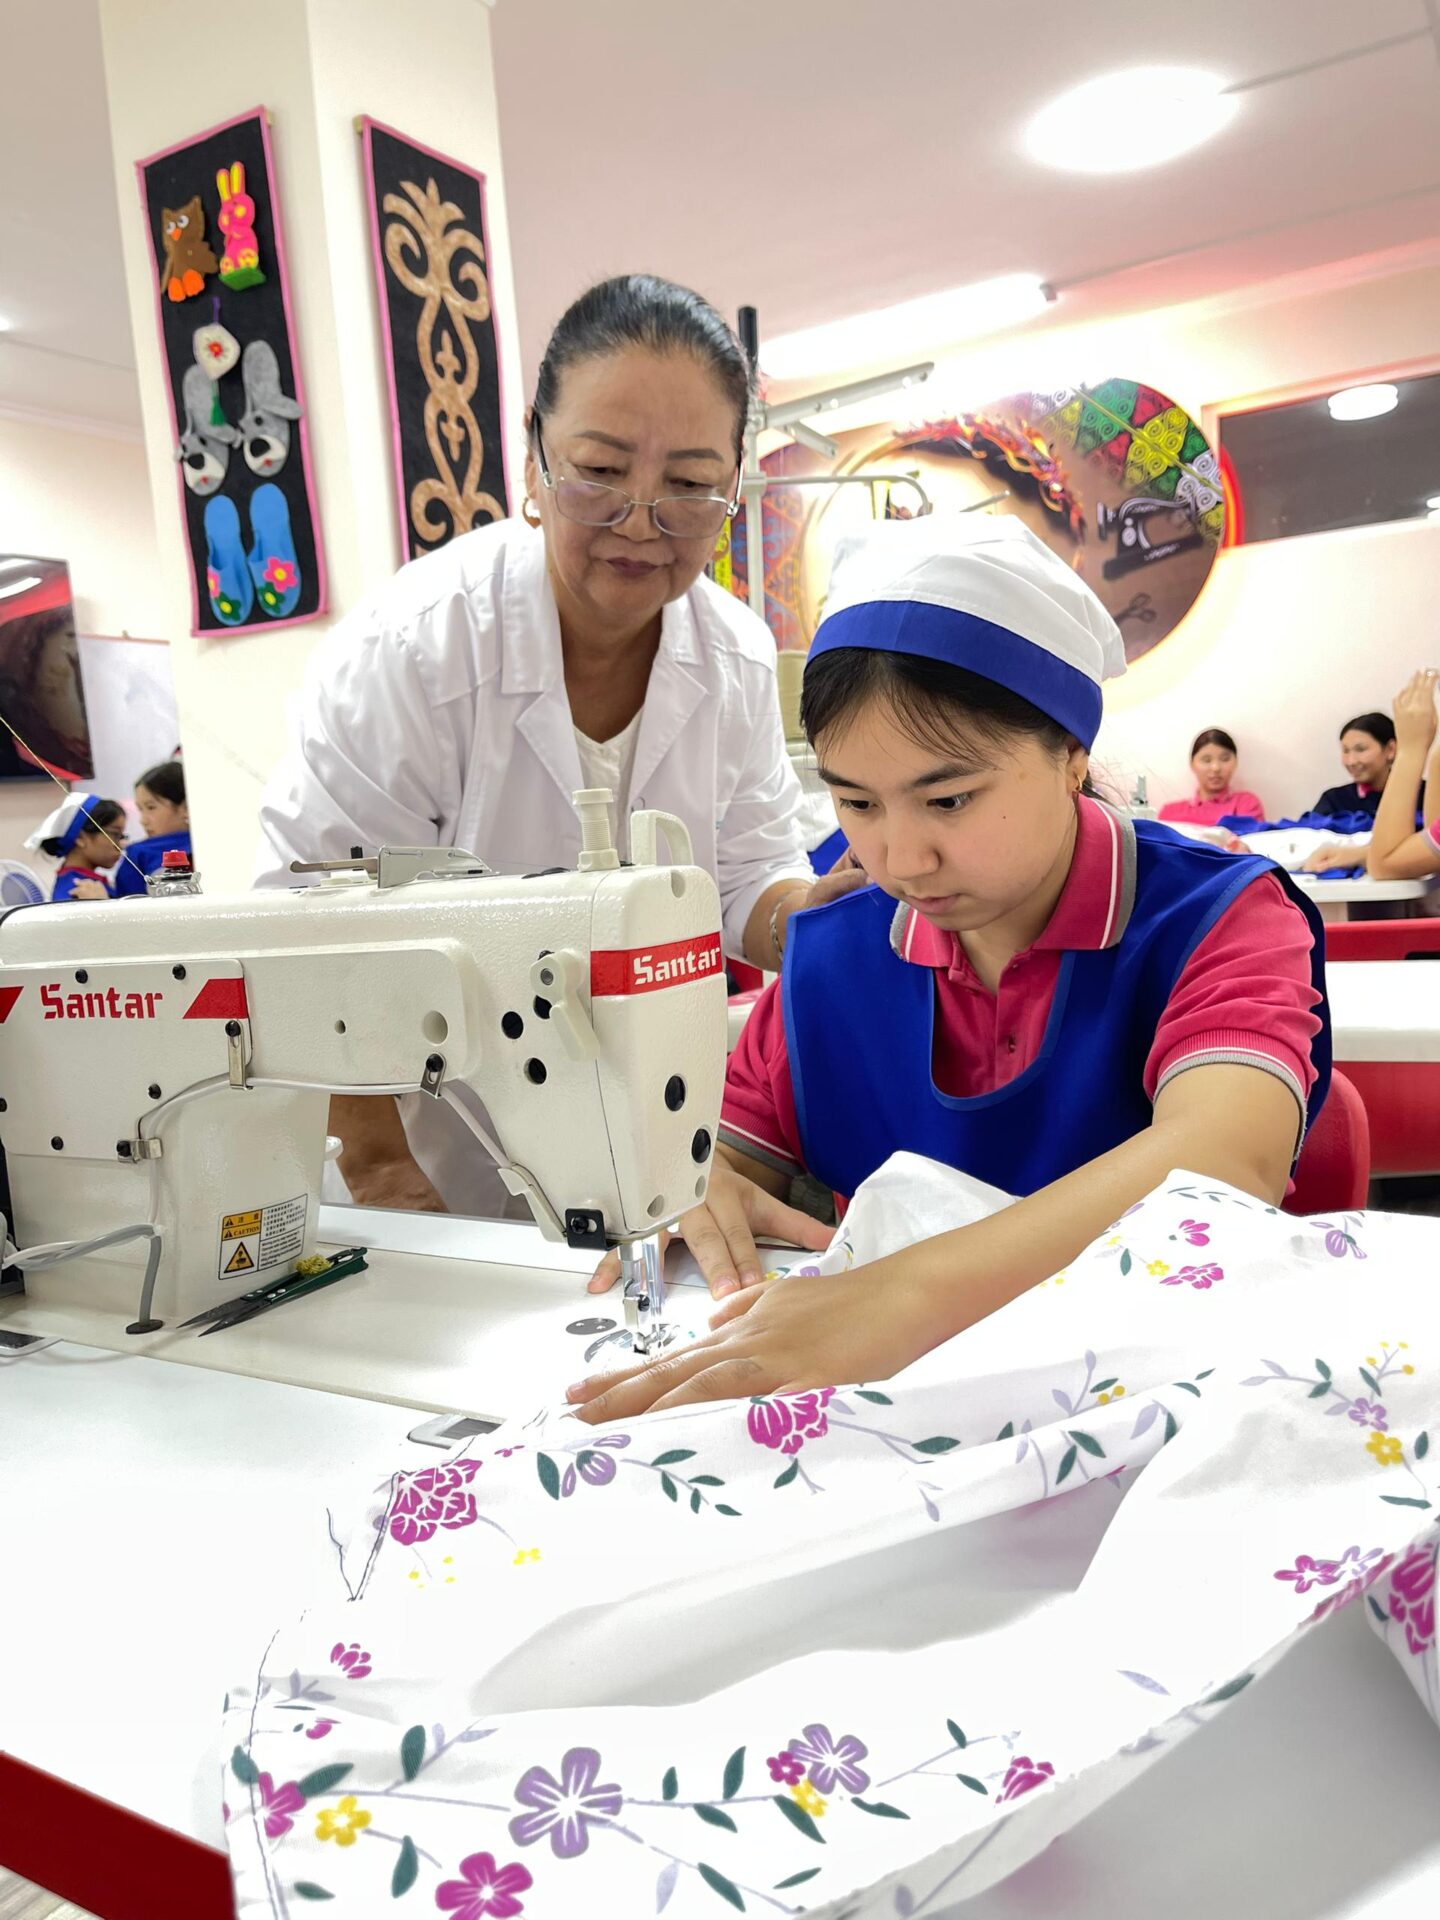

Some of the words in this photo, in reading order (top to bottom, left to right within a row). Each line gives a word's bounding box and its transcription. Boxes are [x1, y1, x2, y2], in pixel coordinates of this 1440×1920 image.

[633, 947, 720, 985] Santar
[40, 983, 163, 1019] Santar
[233, 1226, 260, 1237] CAUTION
